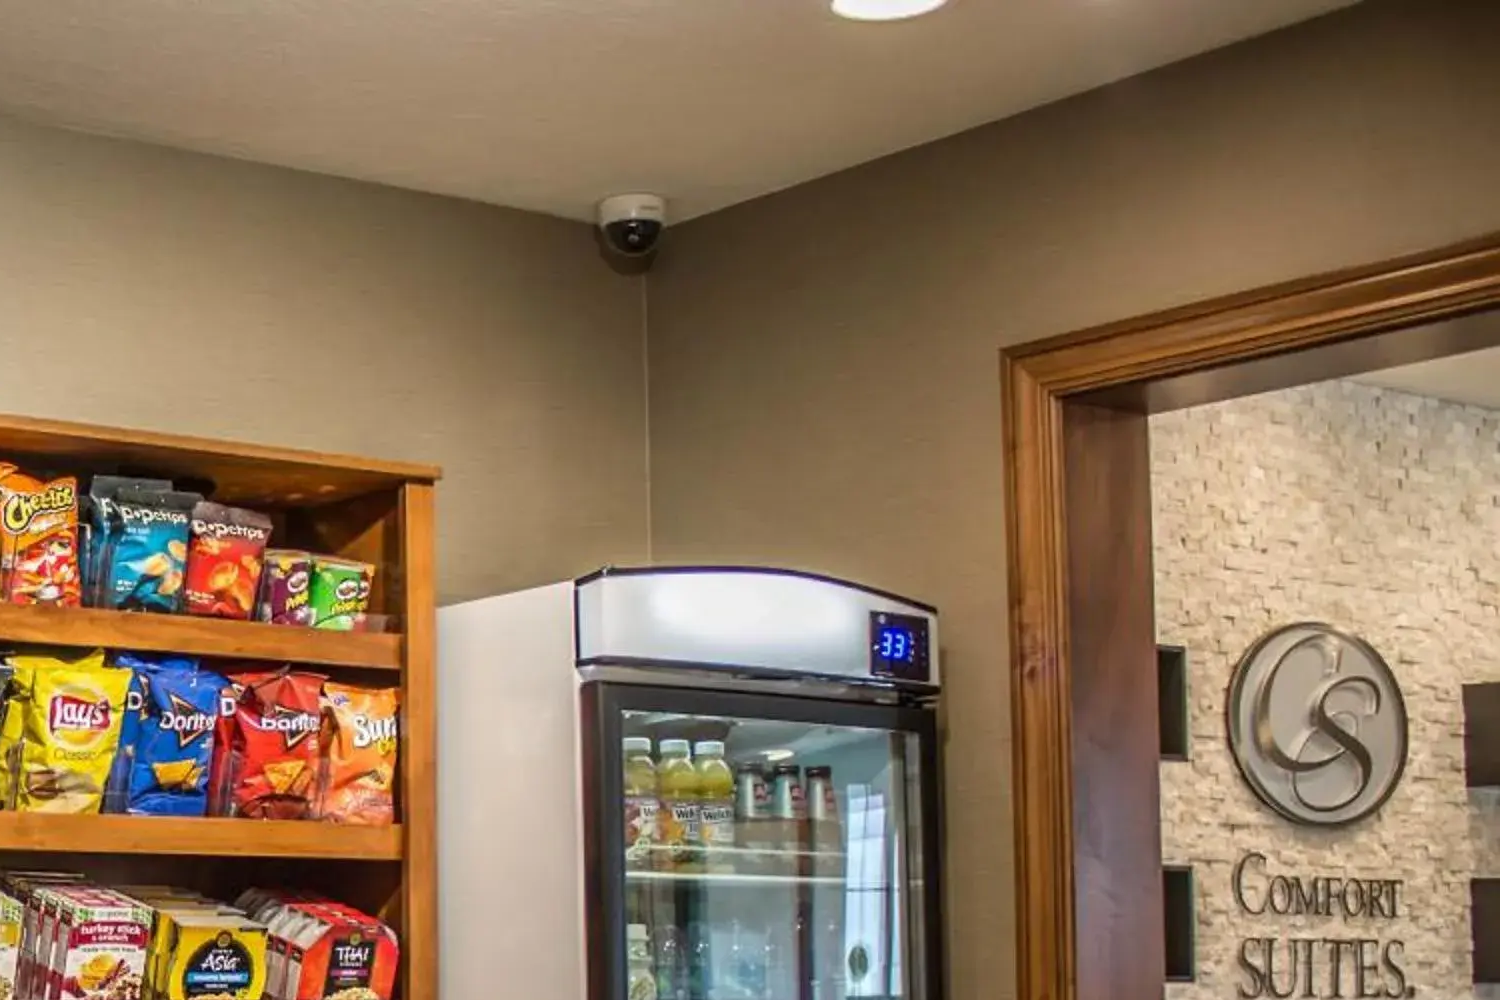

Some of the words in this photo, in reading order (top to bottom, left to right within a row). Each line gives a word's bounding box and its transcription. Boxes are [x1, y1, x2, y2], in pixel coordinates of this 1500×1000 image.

[4, 487, 75, 533] Cheetos
[121, 506, 188, 525] popchips
[192, 519, 266, 541] popchips
[881, 631, 905, 658] 33
[52, 695, 109, 729] Lay's
[160, 710, 216, 732] Doritos
[80, 925, 115, 936] turkey
[201, 953, 237, 972] Asia
[335, 946, 370, 962] THAI
